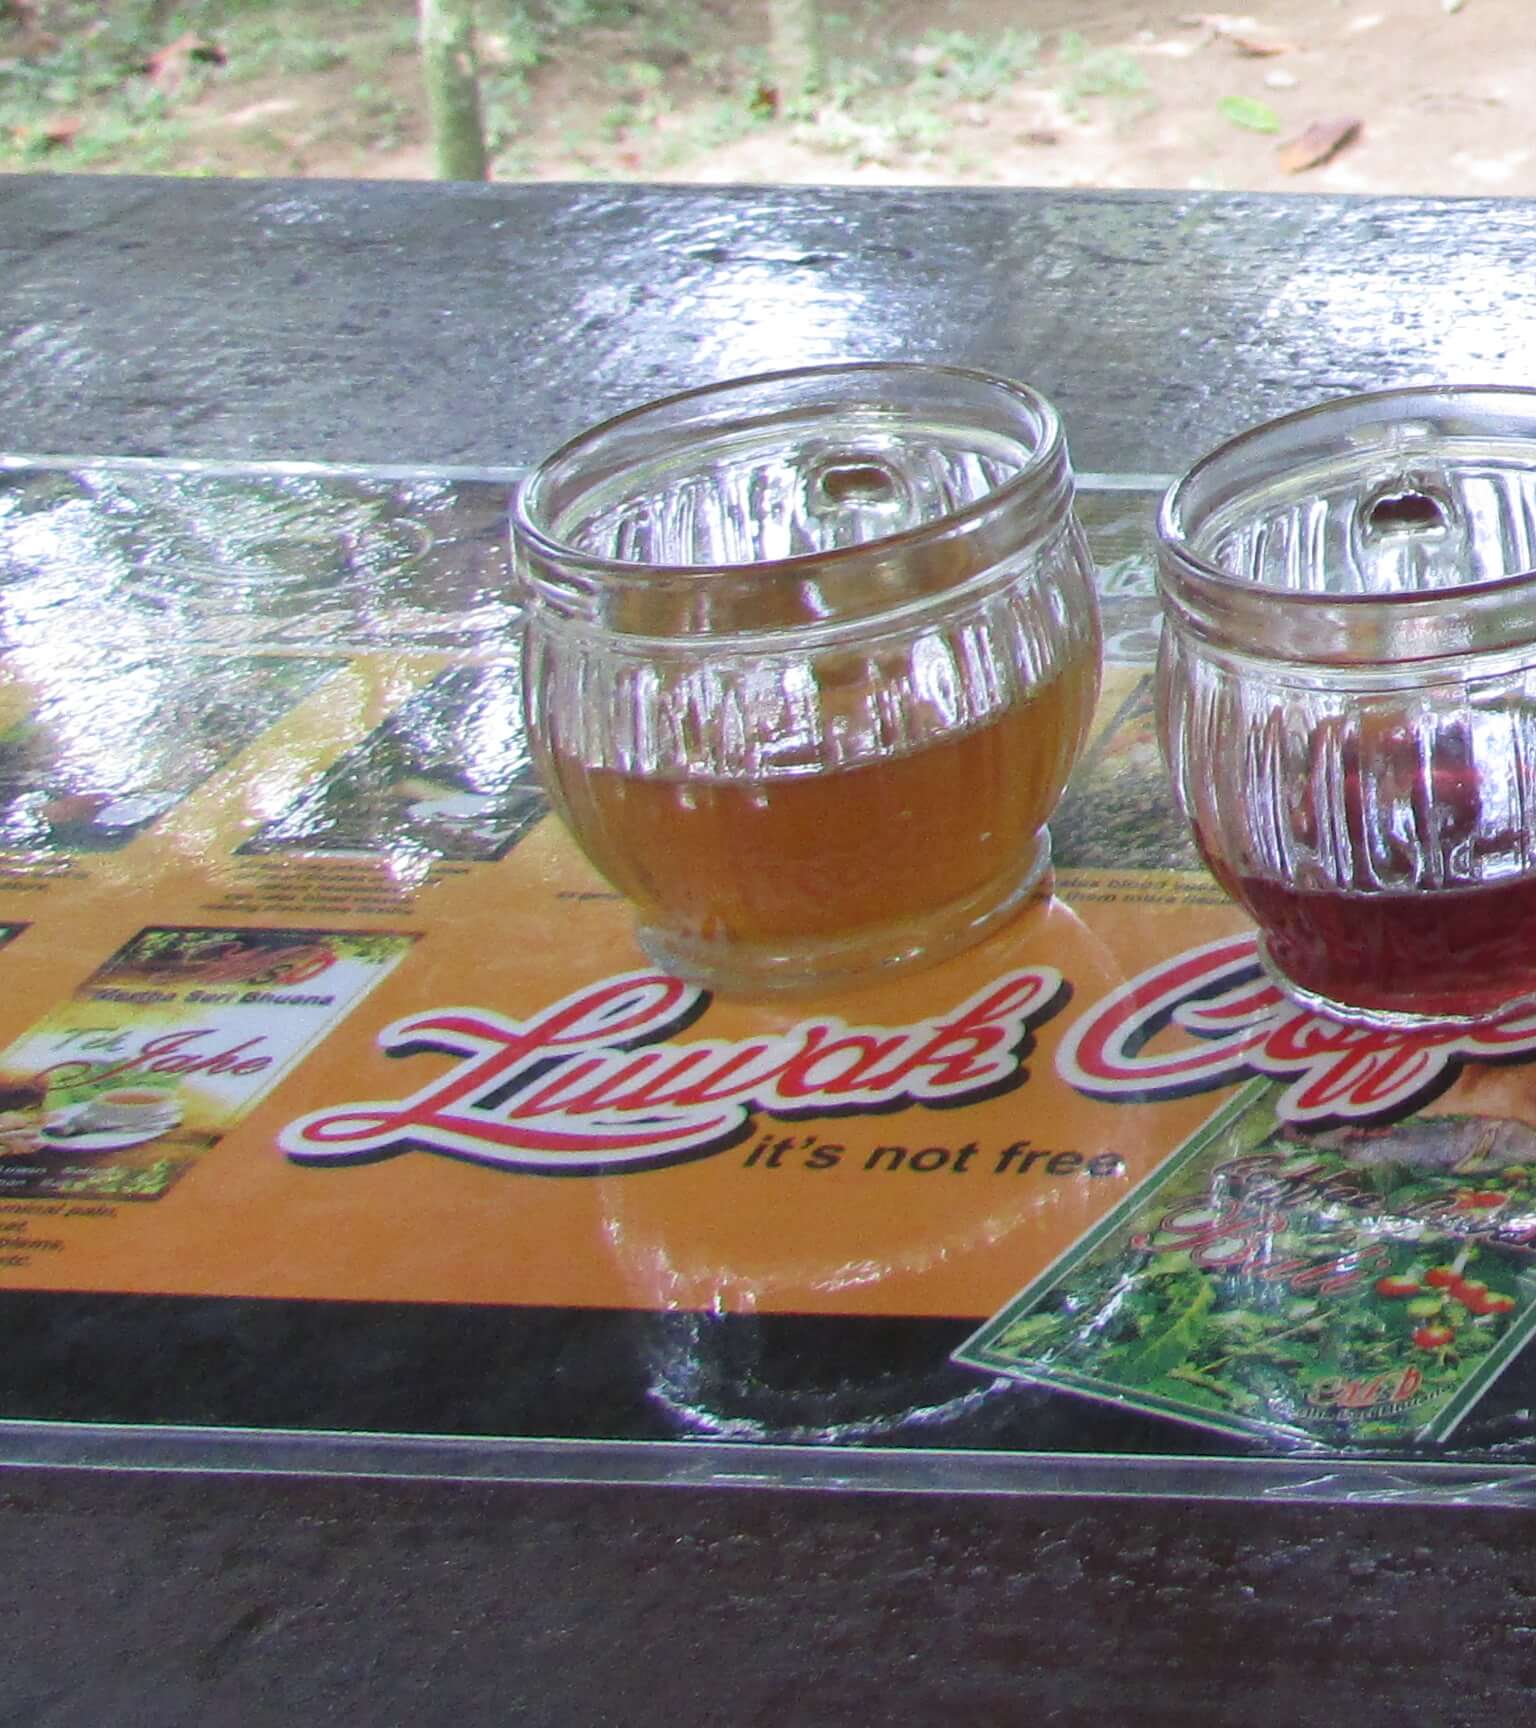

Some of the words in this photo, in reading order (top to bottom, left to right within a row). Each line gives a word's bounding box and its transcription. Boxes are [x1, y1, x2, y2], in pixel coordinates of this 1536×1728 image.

[280, 968, 1063, 1168] Luwak
[744, 1133, 845, 1172] it's
[864, 1142, 985, 1175] not
[994, 1139, 1124, 1177] free
